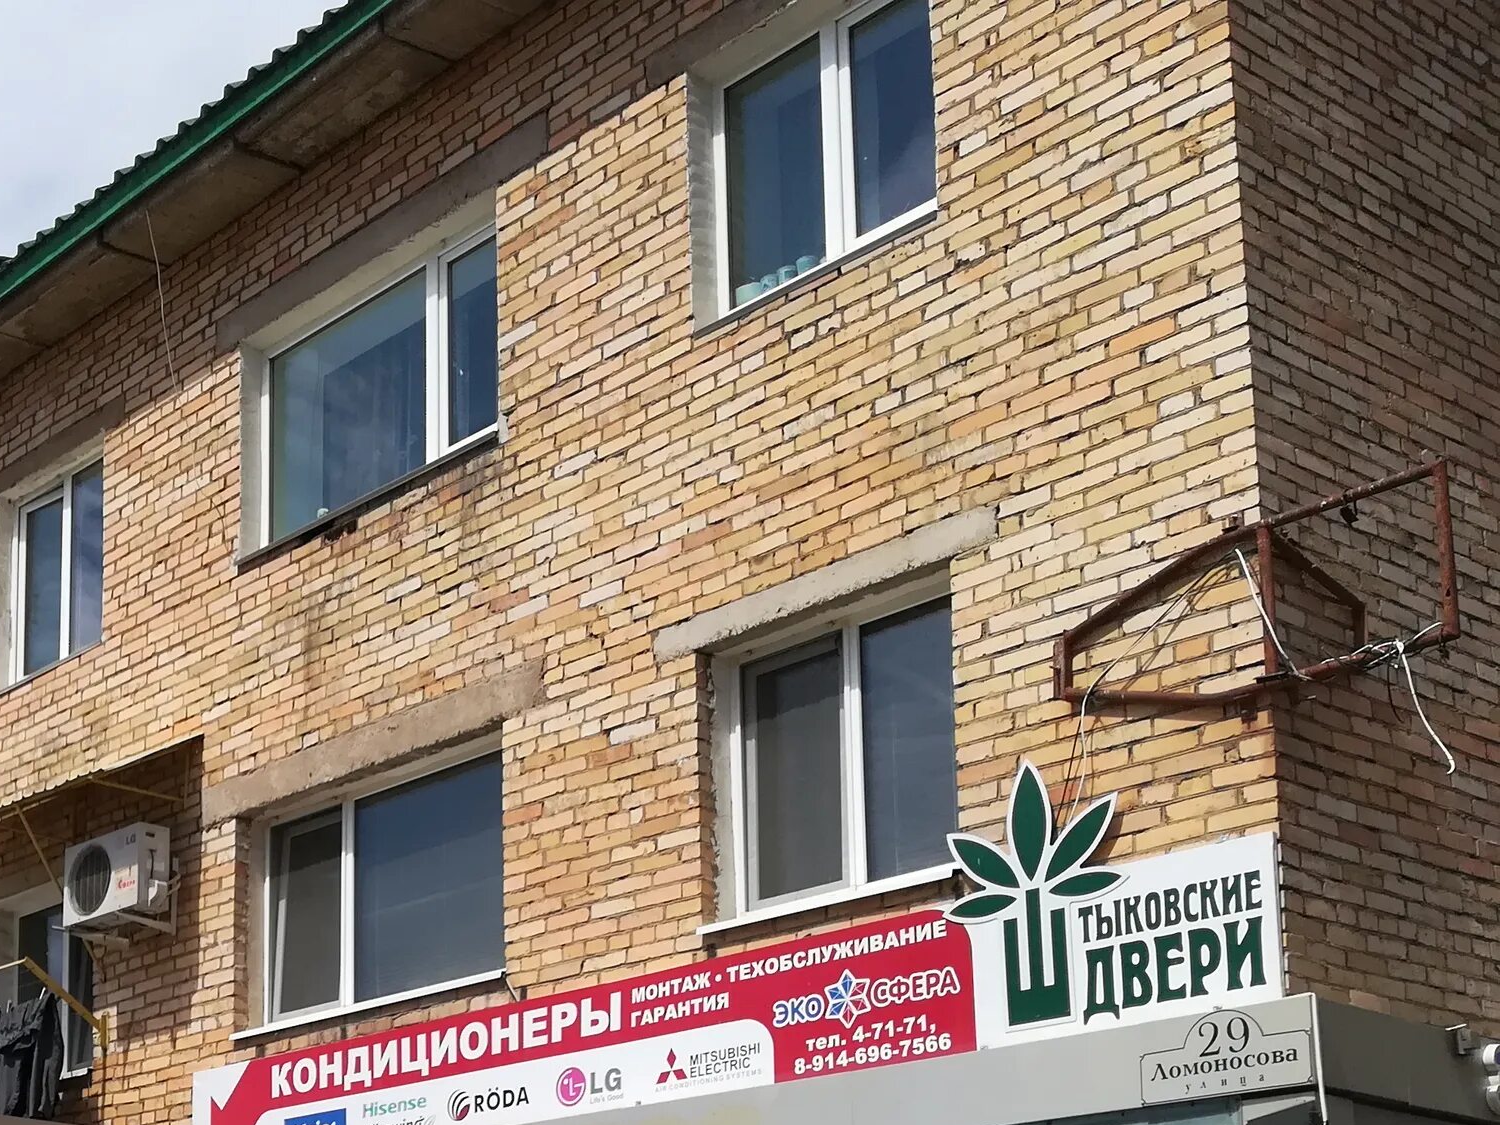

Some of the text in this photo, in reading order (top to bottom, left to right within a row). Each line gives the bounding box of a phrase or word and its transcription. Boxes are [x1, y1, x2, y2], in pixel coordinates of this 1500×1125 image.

[125, 833, 136, 845] LG
[1077, 869, 1263, 944] ТЫКОВСКИЕ
[631, 919, 948, 1004] МОНТАЖ ТЕХОБСЛУЖИВАНИЕ
[1082, 915, 1268, 1026] ДВЕРИ
[630, 992, 730, 1028] ГАРАНТИЯ
[773, 967, 961, 1028] ЭКО СФЕРА
[270, 991, 623, 1099] КОНДИЦИОНЕРЫ
[806, 1014, 937, 1052] тел. 4-71-71,
[1198, 1016, 1251, 1058] 29
[689, 1042, 761, 1067] MITSUBISHI
[690, 1057, 751, 1079] ELECTRIC
[794, 1033, 952, 1076] 8-914-696-7566
[1150, 1047, 1299, 1082] Ломоносова
[590, 1067, 623, 1095] LG
[669, 1074, 725, 1092] CONDITIONING
[726, 1068, 763, 1082] SYSTEMS
[362, 1095, 428, 1119] Hisense
[474, 1086, 530, 1114] RÖDA
